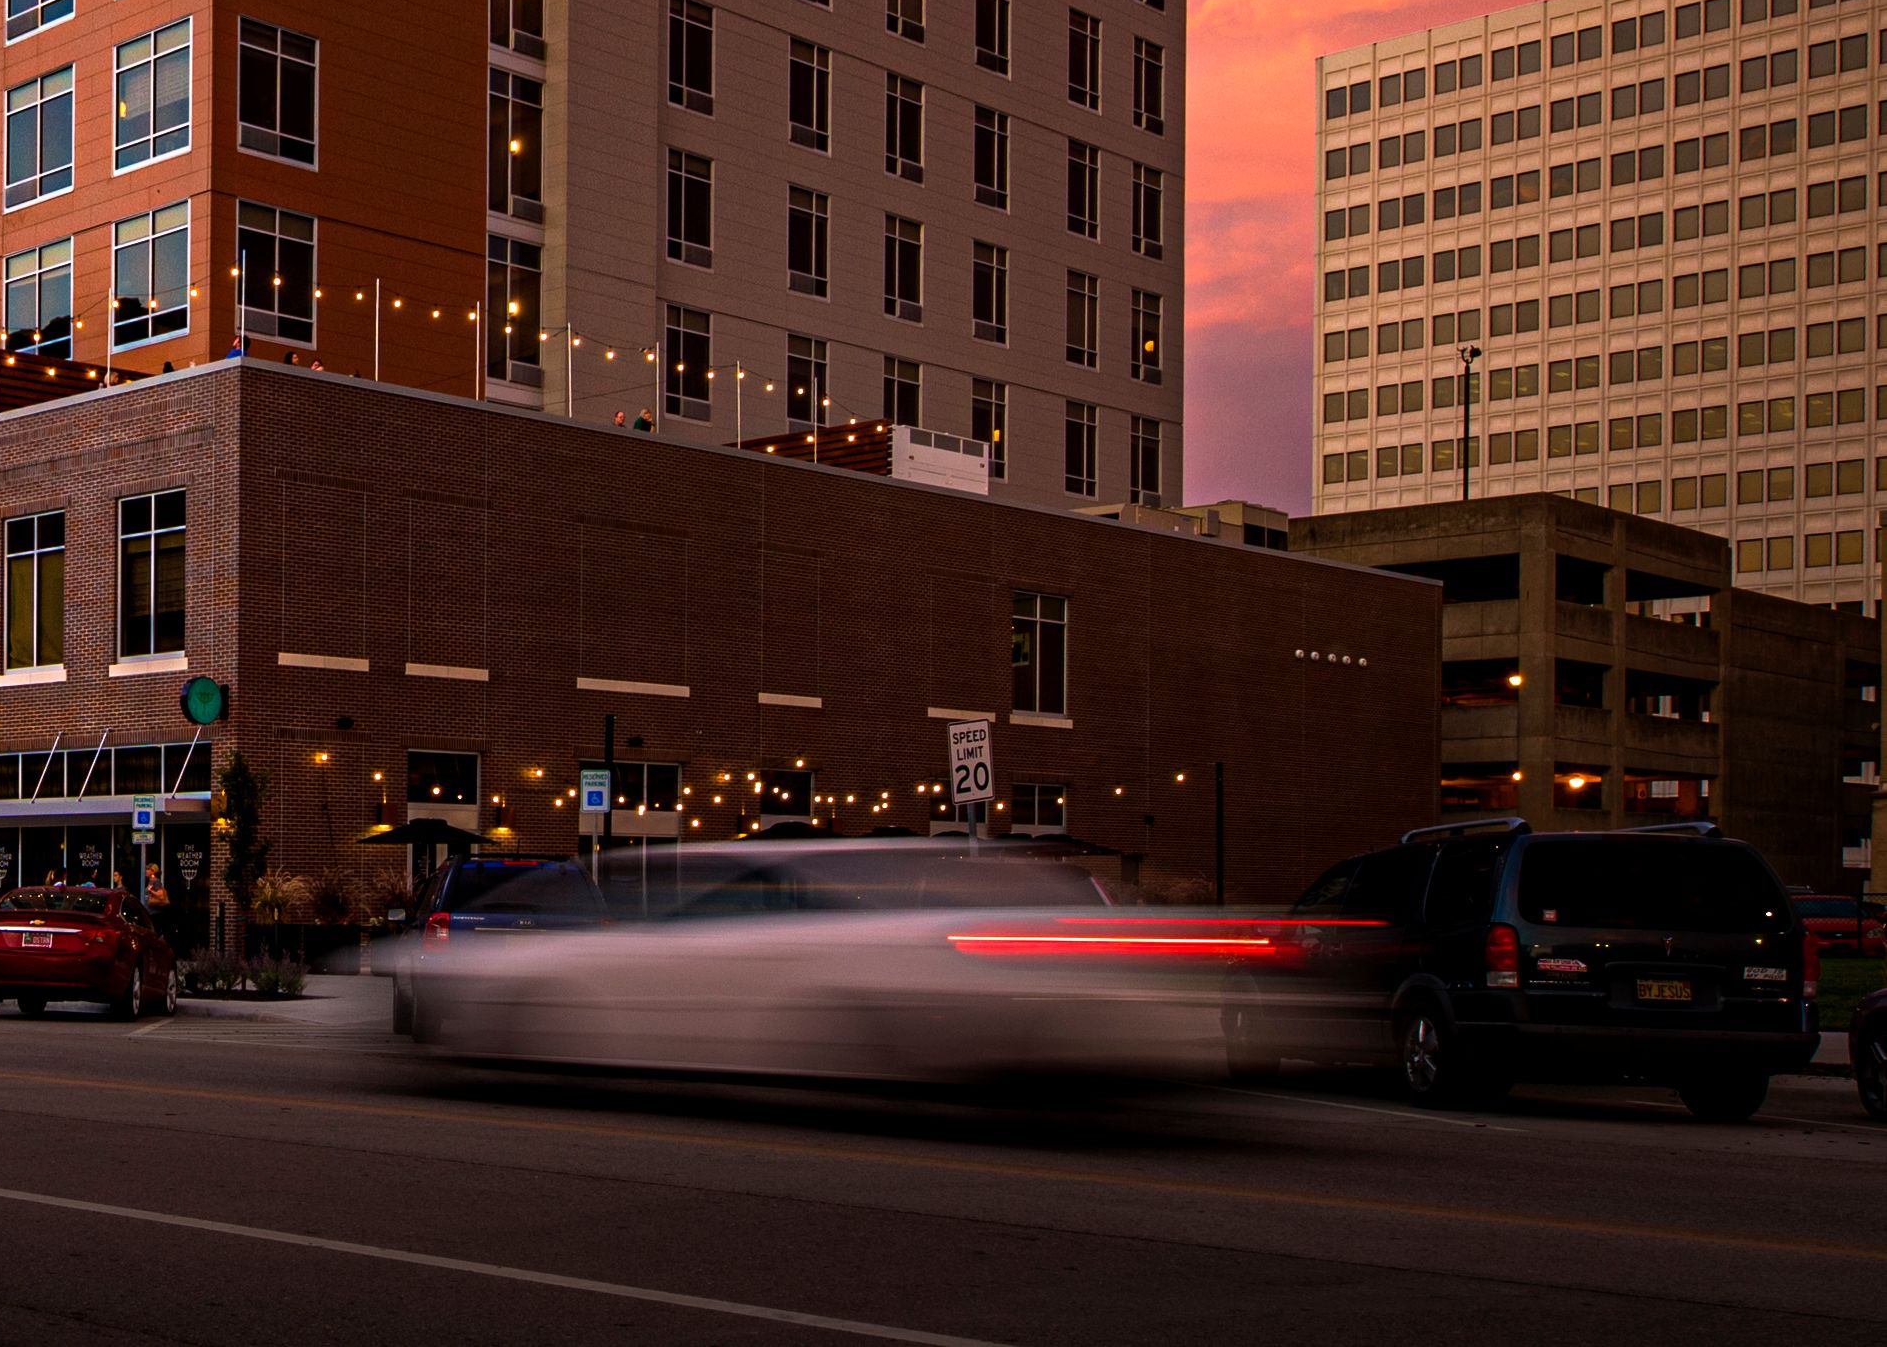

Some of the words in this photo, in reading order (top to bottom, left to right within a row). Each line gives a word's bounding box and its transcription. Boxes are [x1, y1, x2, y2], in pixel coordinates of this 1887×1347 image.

[952, 729, 987, 745] SPEED
[956, 746, 984, 761] LIMIT
[955, 762, 989, 794] 20
[176, 851, 203, 859] WEATHER
[179, 859, 200, 867] ROOM
